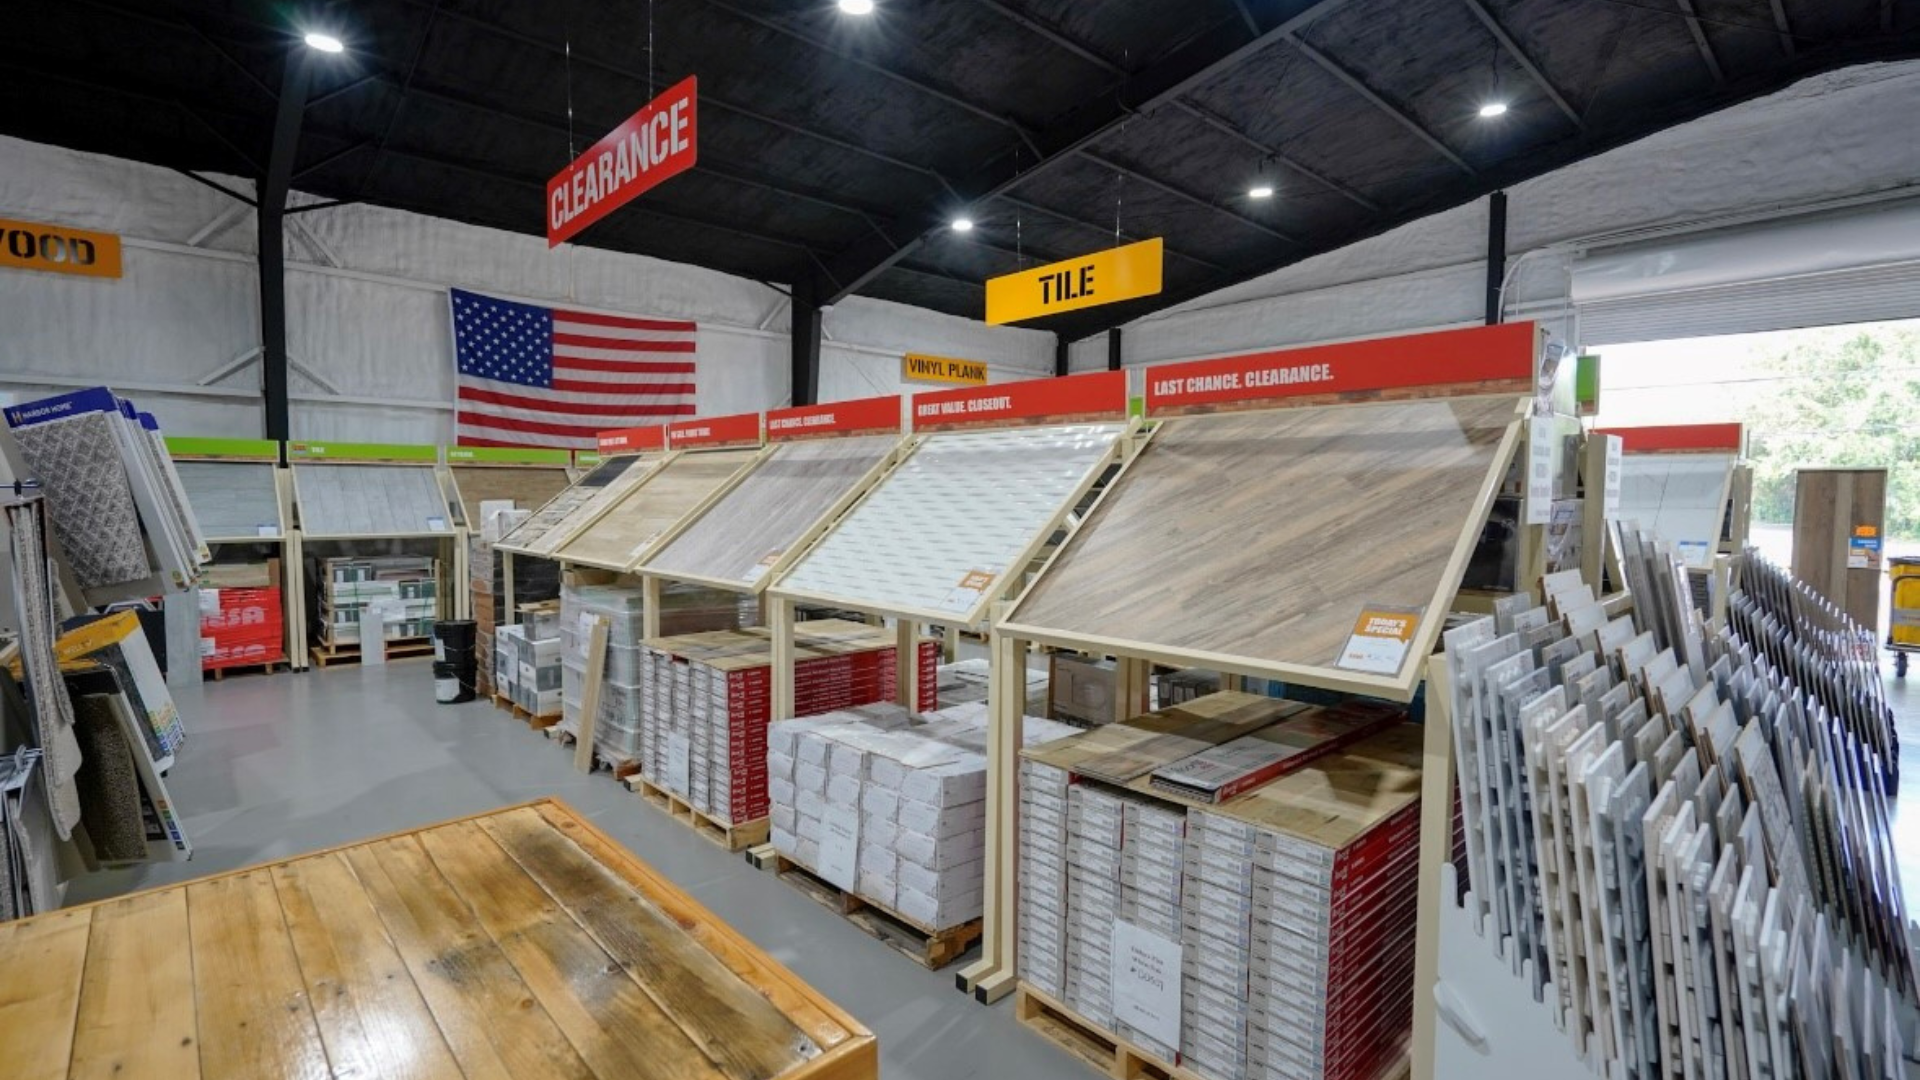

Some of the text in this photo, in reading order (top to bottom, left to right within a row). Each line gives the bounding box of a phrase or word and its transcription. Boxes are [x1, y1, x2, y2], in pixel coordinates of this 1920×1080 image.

[551, 97, 689, 230] CLEARANCE
[0, 229, 95, 265] OOD
[1039, 265, 1094, 304] TILE
[909, 359, 985, 380] VINYL PLANK
[1154, 363, 1334, 396] LAST CHANCE. CLEARANCE.
